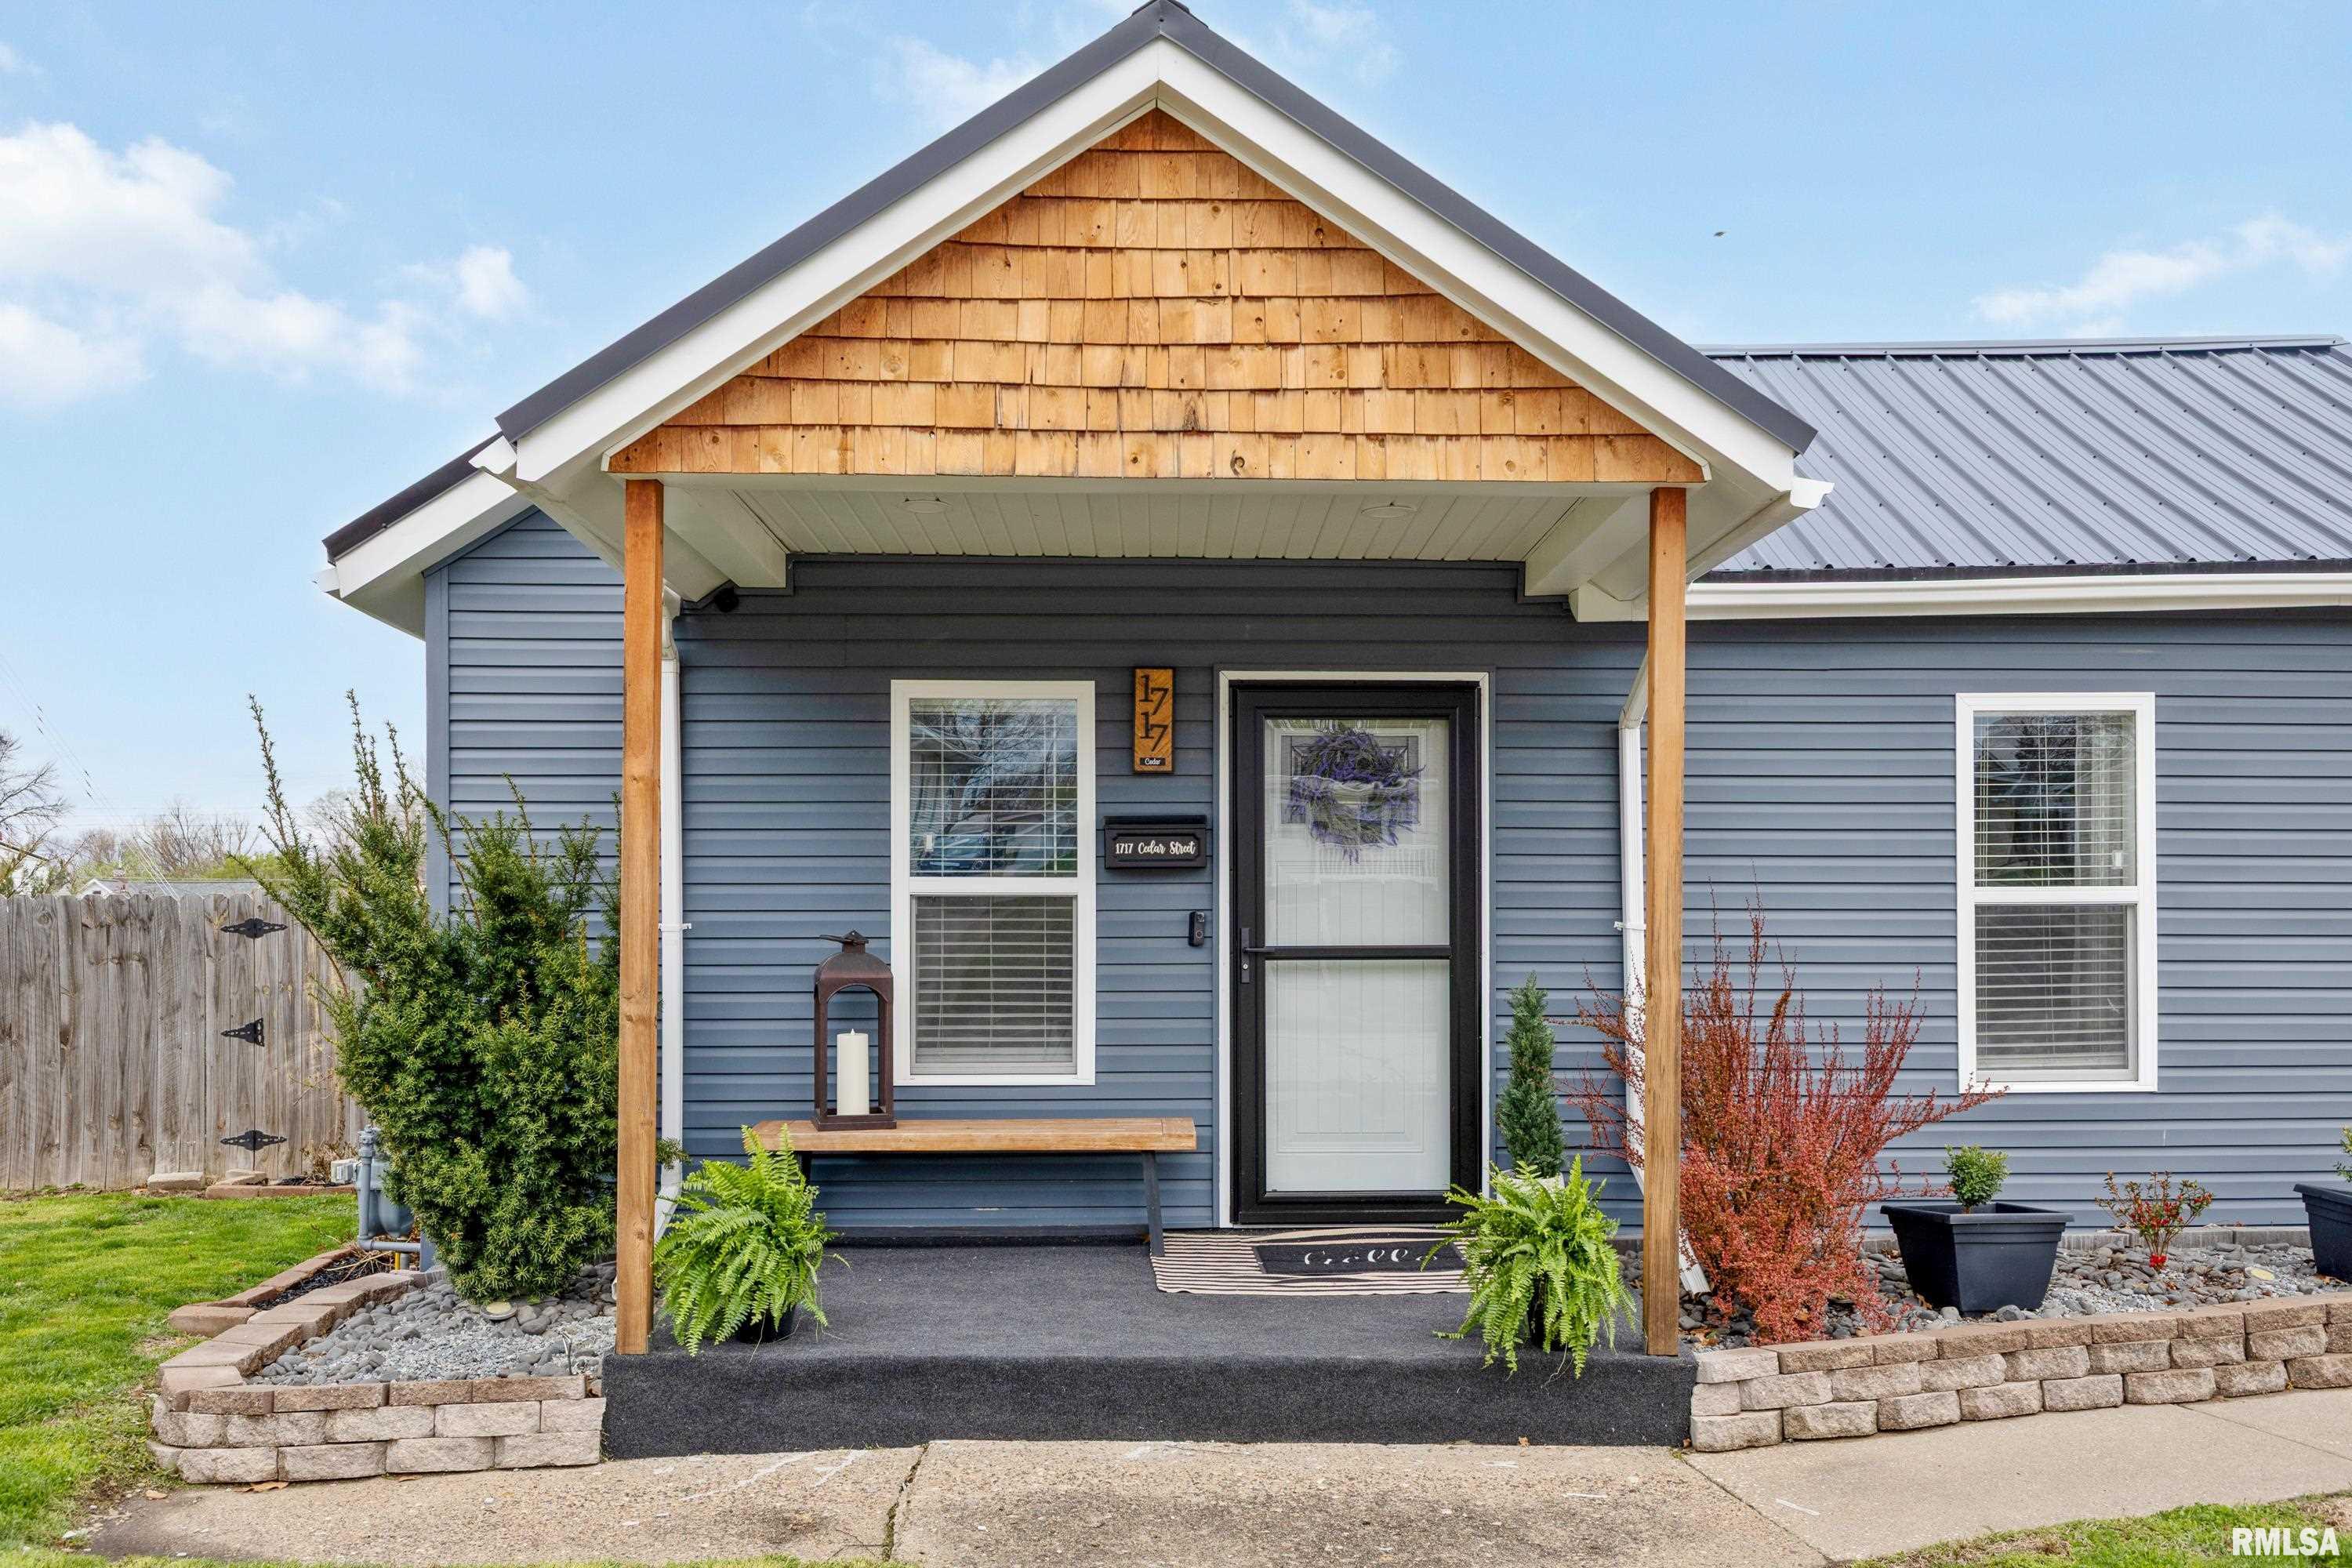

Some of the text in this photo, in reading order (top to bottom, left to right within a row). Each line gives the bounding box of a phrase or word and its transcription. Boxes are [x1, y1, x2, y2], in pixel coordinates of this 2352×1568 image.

[1139, 674, 1169, 752] 1717
[1145, 757, 1160, 766] Cedar
[1116, 840, 1196, 855] 1717 Cedar Street
